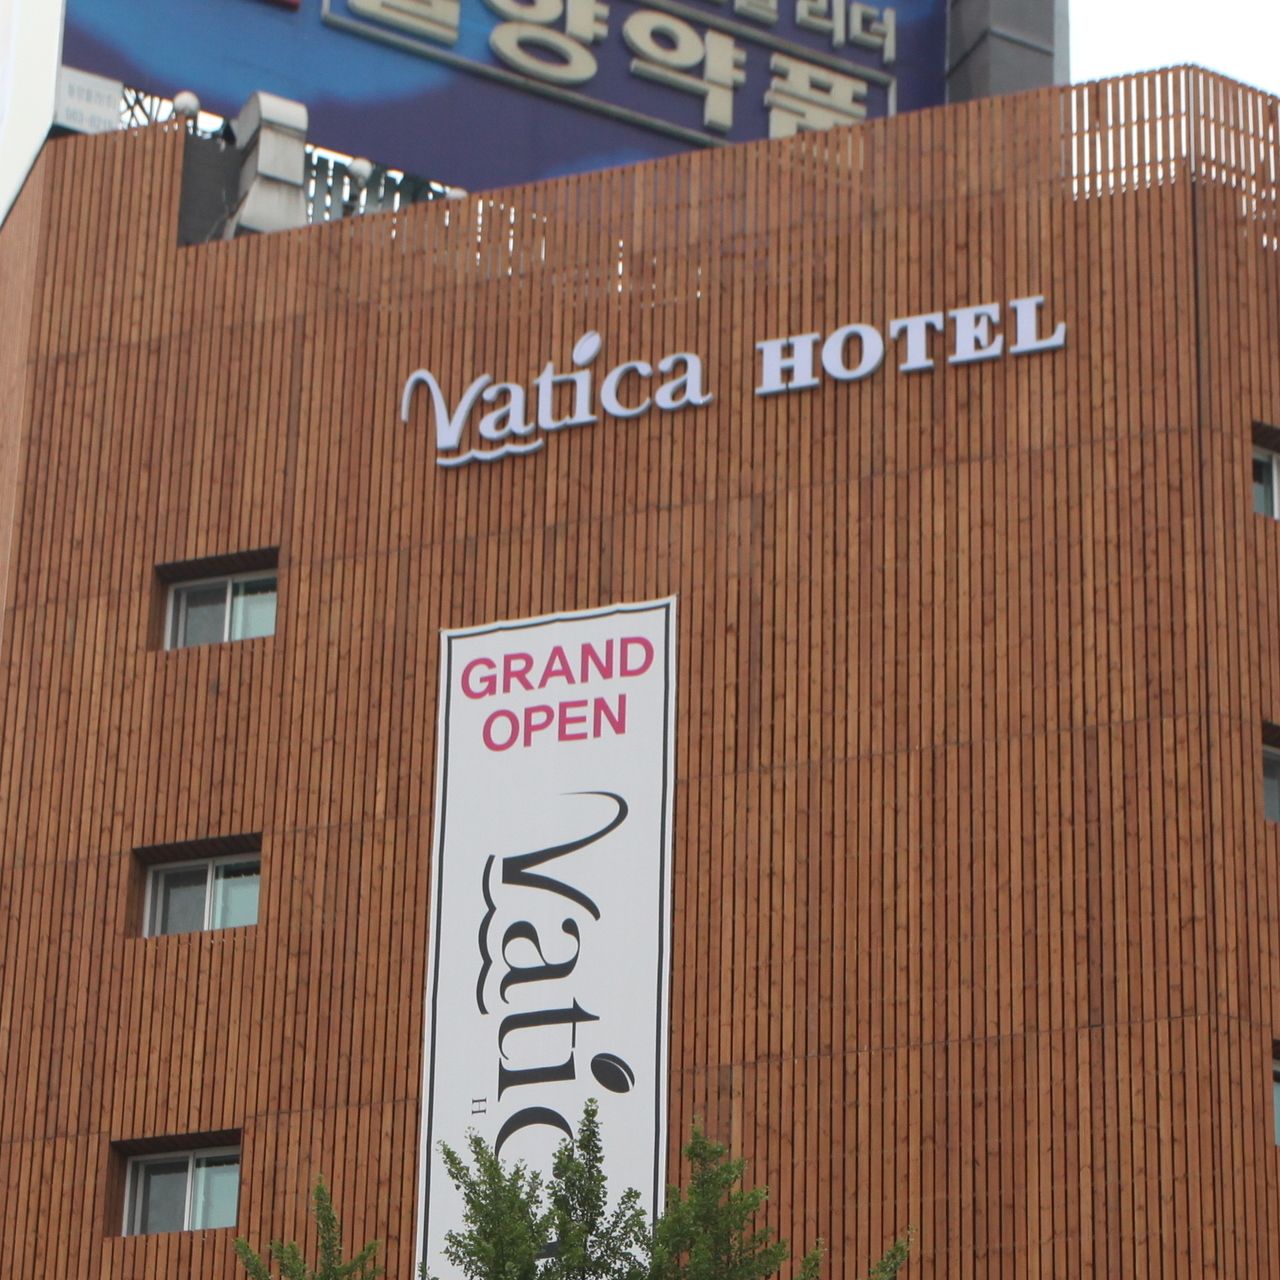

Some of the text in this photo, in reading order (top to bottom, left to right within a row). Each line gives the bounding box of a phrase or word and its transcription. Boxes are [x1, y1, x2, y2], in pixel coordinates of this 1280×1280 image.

[400, 294, 1068, 467] Vatica HOTEL
[460, 636, 655, 700] GRAND
[482, 693, 627, 752] OPEN
